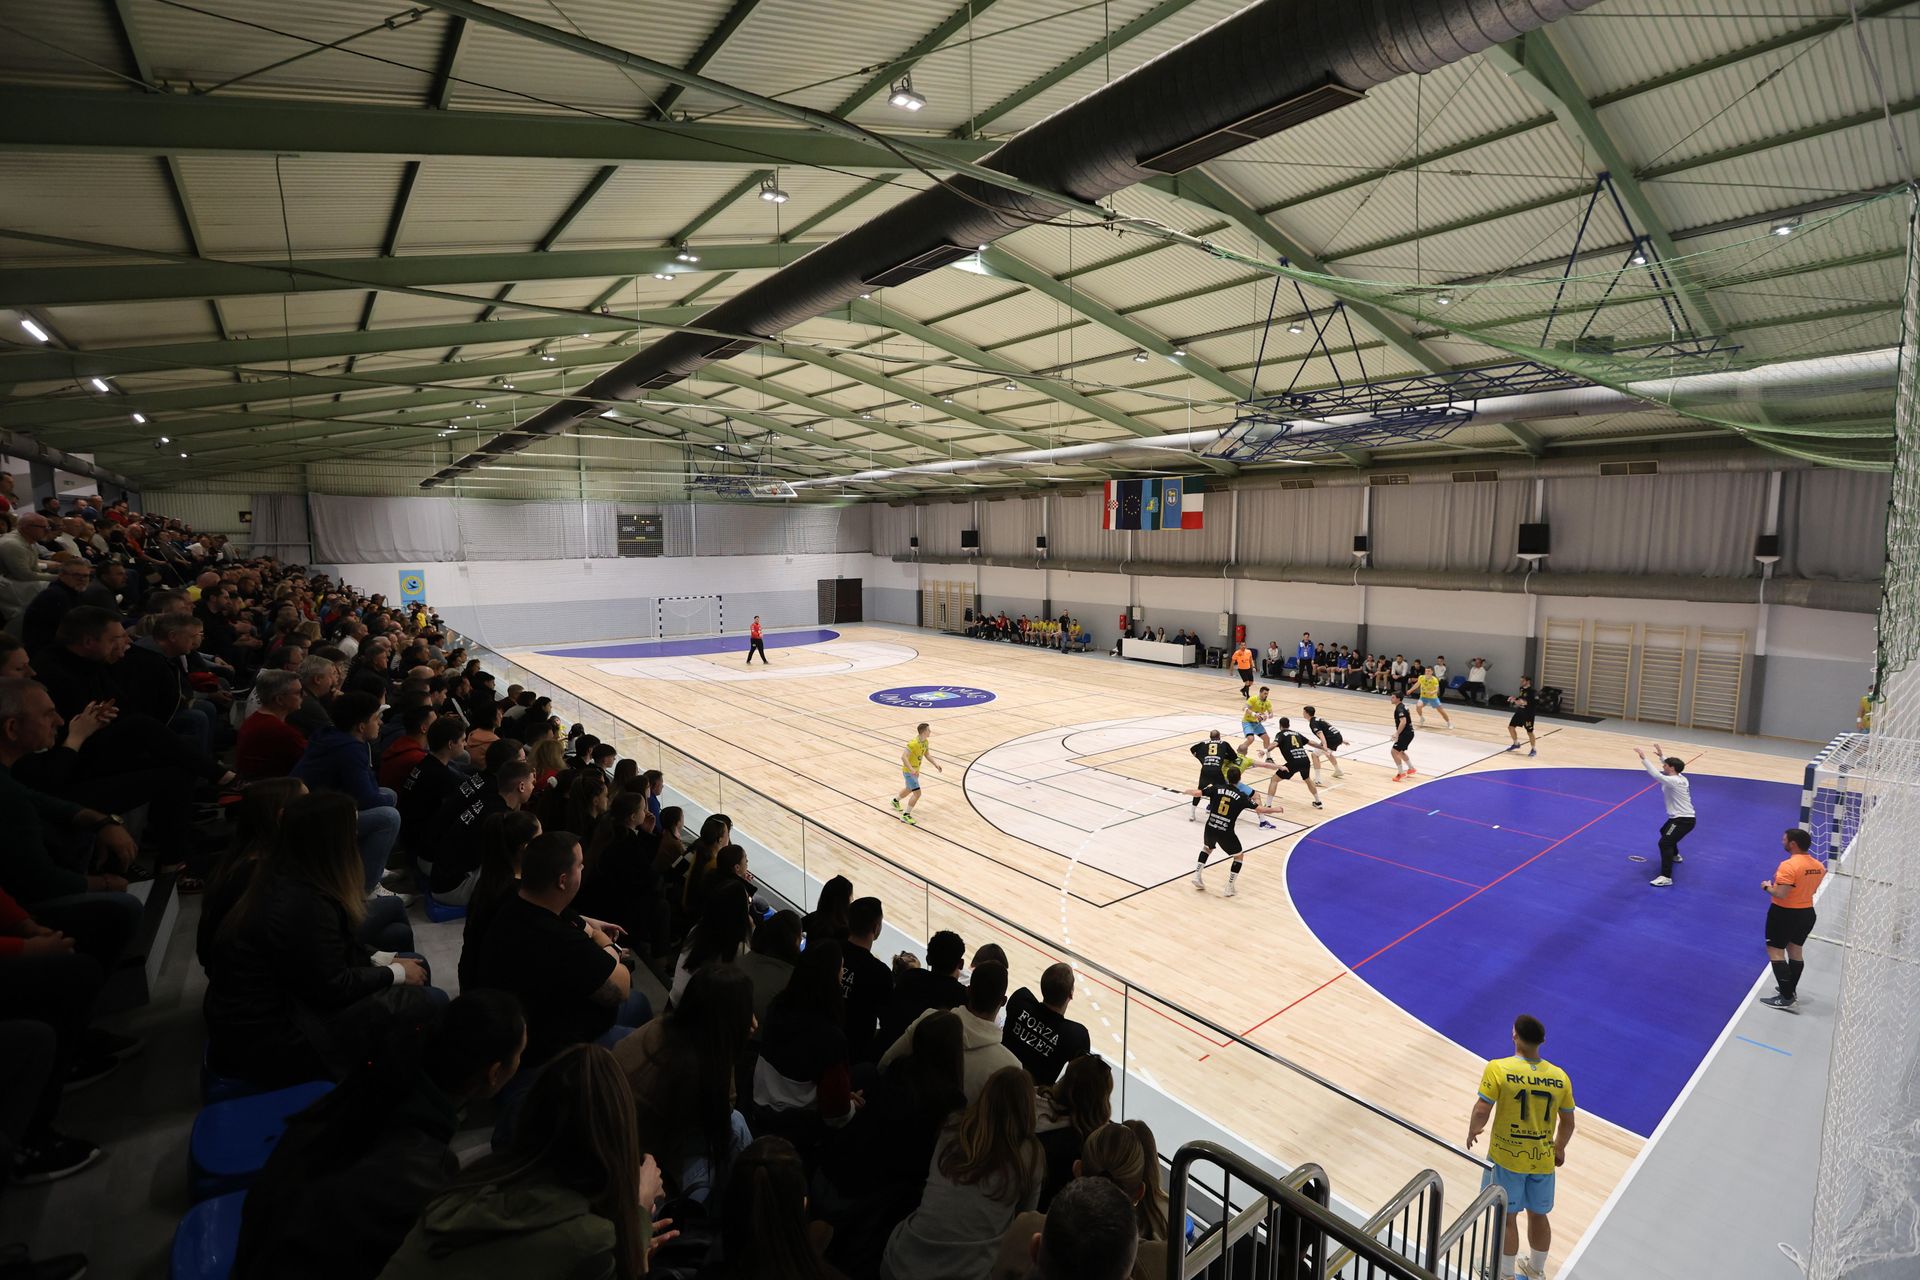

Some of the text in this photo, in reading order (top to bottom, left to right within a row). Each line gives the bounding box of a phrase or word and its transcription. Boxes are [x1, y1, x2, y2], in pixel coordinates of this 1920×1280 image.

[1291, 735, 1300, 747] 4
[1218, 796, 1231, 816] 6
[1013, 1022, 1054, 1057] BUZET
[1018, 1010, 1059, 1046] FORZA
[1506, 1074, 1564, 1088] RK UMAG
[1514, 1089, 1553, 1121] 17
